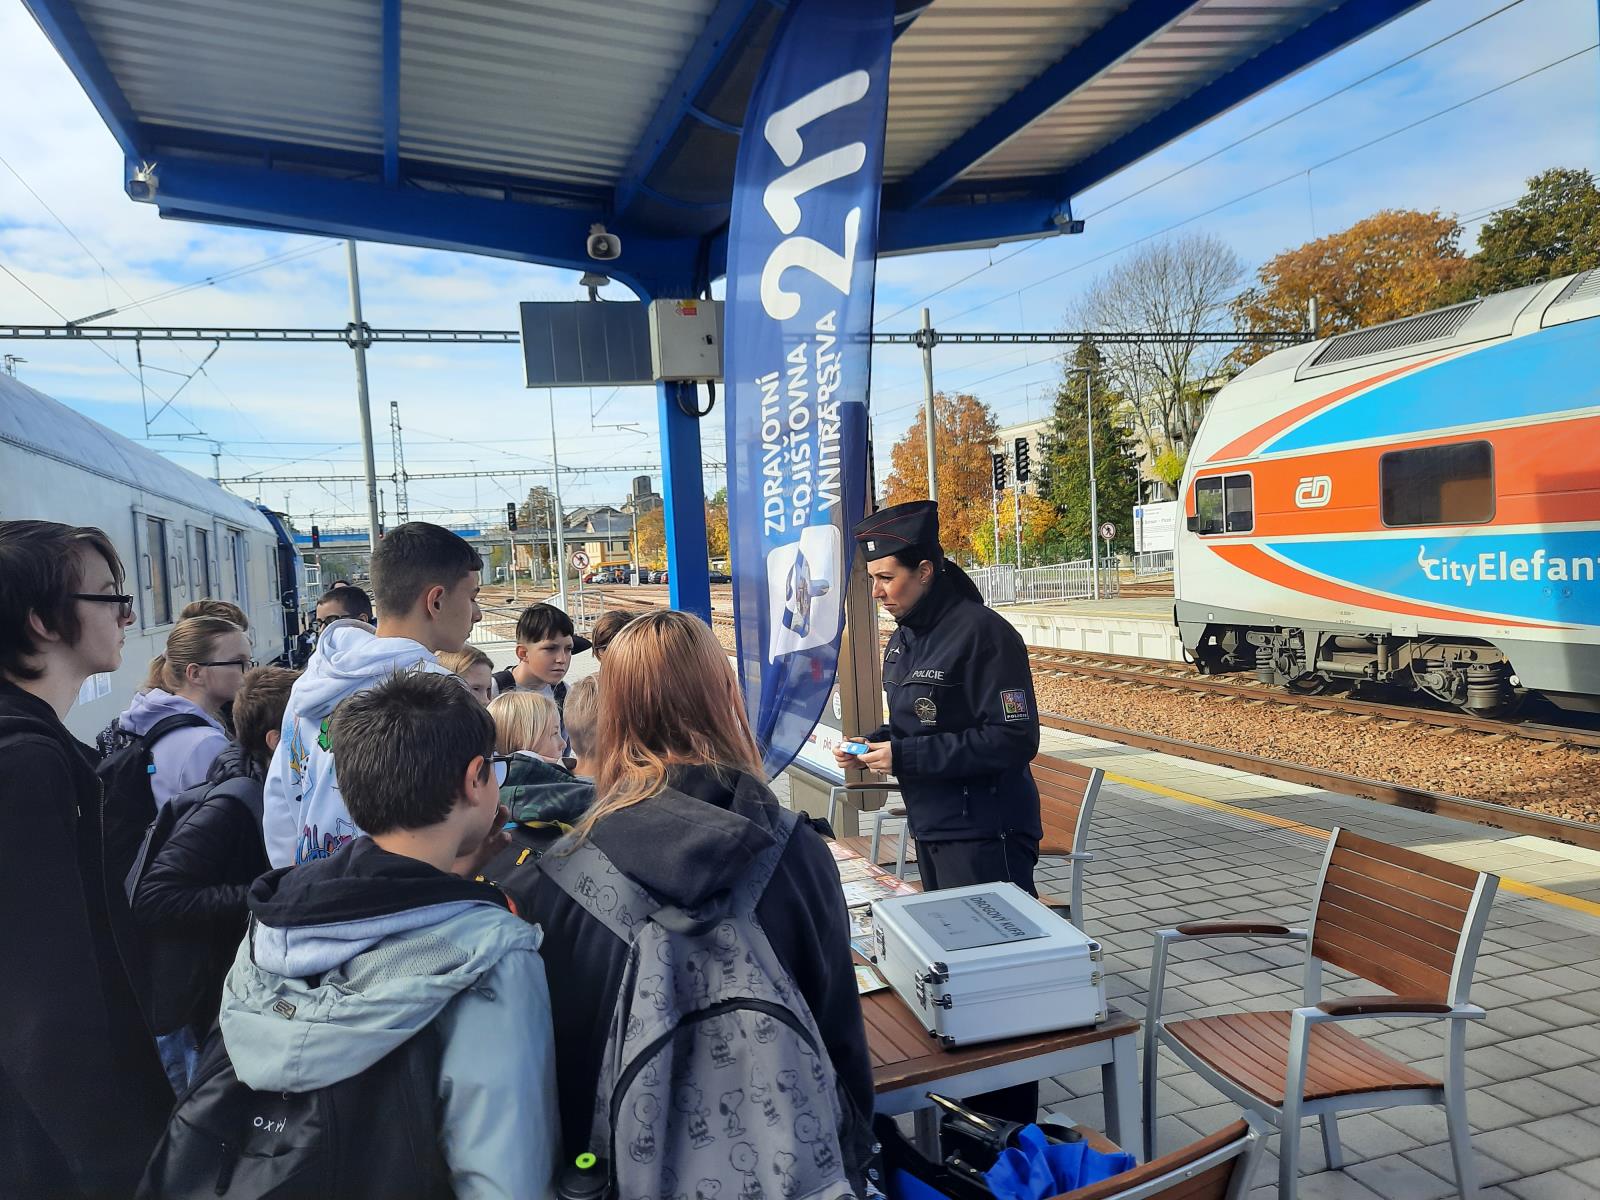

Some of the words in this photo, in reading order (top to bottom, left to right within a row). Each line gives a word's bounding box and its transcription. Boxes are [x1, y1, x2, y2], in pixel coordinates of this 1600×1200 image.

[760, 69, 870, 321] 211
[755, 371, 785, 536] ZDRAVOTNÍ
[782, 342, 811, 527] POJIŠŤOVNA
[818, 400, 841, 511] VNITRA
[1418, 545, 1600, 587] CityElefan
[912, 670, 945, 680] POLICIE
[1000, 921, 1026, 937] KUFR
